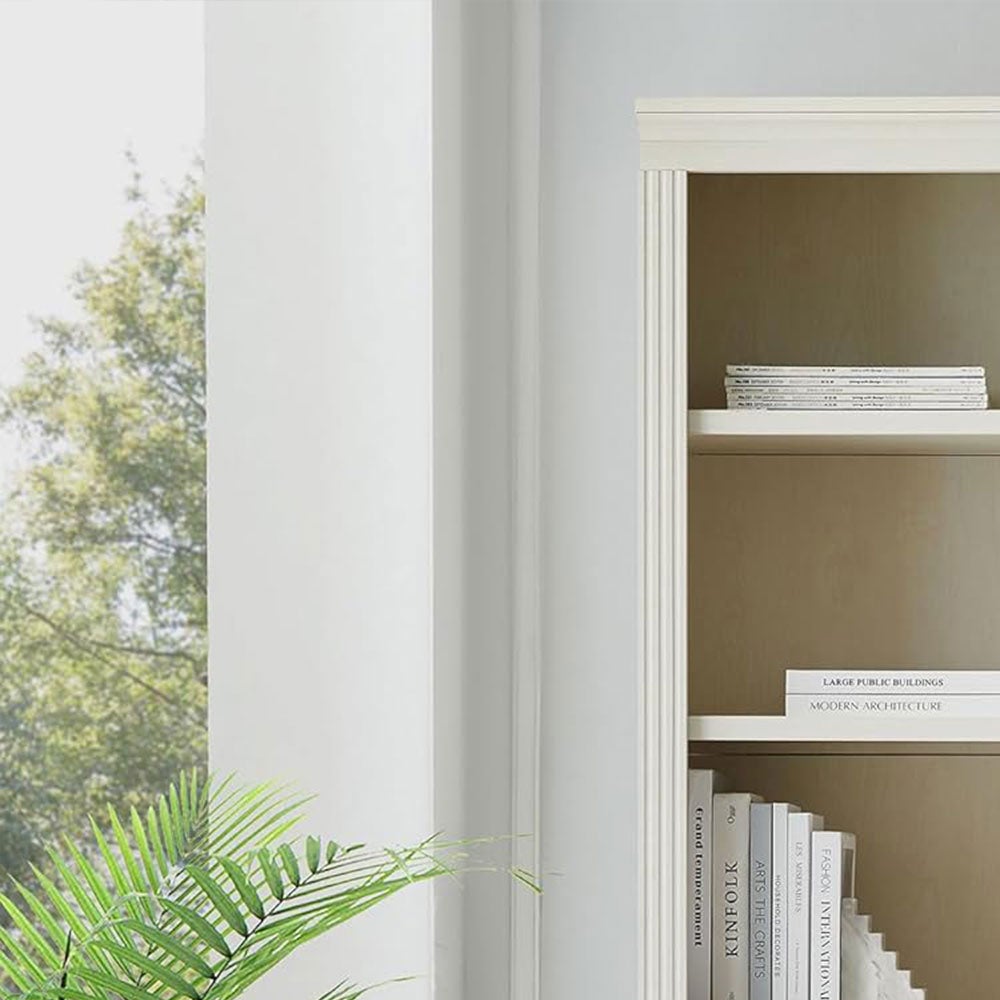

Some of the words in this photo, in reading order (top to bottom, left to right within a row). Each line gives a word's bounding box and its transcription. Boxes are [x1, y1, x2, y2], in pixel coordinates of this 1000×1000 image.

[823, 678, 854, 687] LARGE
[856, 678, 891, 687] PUBLIC
[892, 678, 944, 687] BUILDINGS
[809, 701, 860, 712] MODERN
[862, 701, 943, 712] ARCHITECTURE
[695, 807, 704, 849] Grand
[754, 860, 768, 894] ARTS
[820, 848, 833, 895] FASHION
[694, 853, 704, 946] temperament
[724, 861, 739, 958] KINFOLK
[754, 899, 768, 925] THE
[753, 930, 768, 980] CRAFTS
